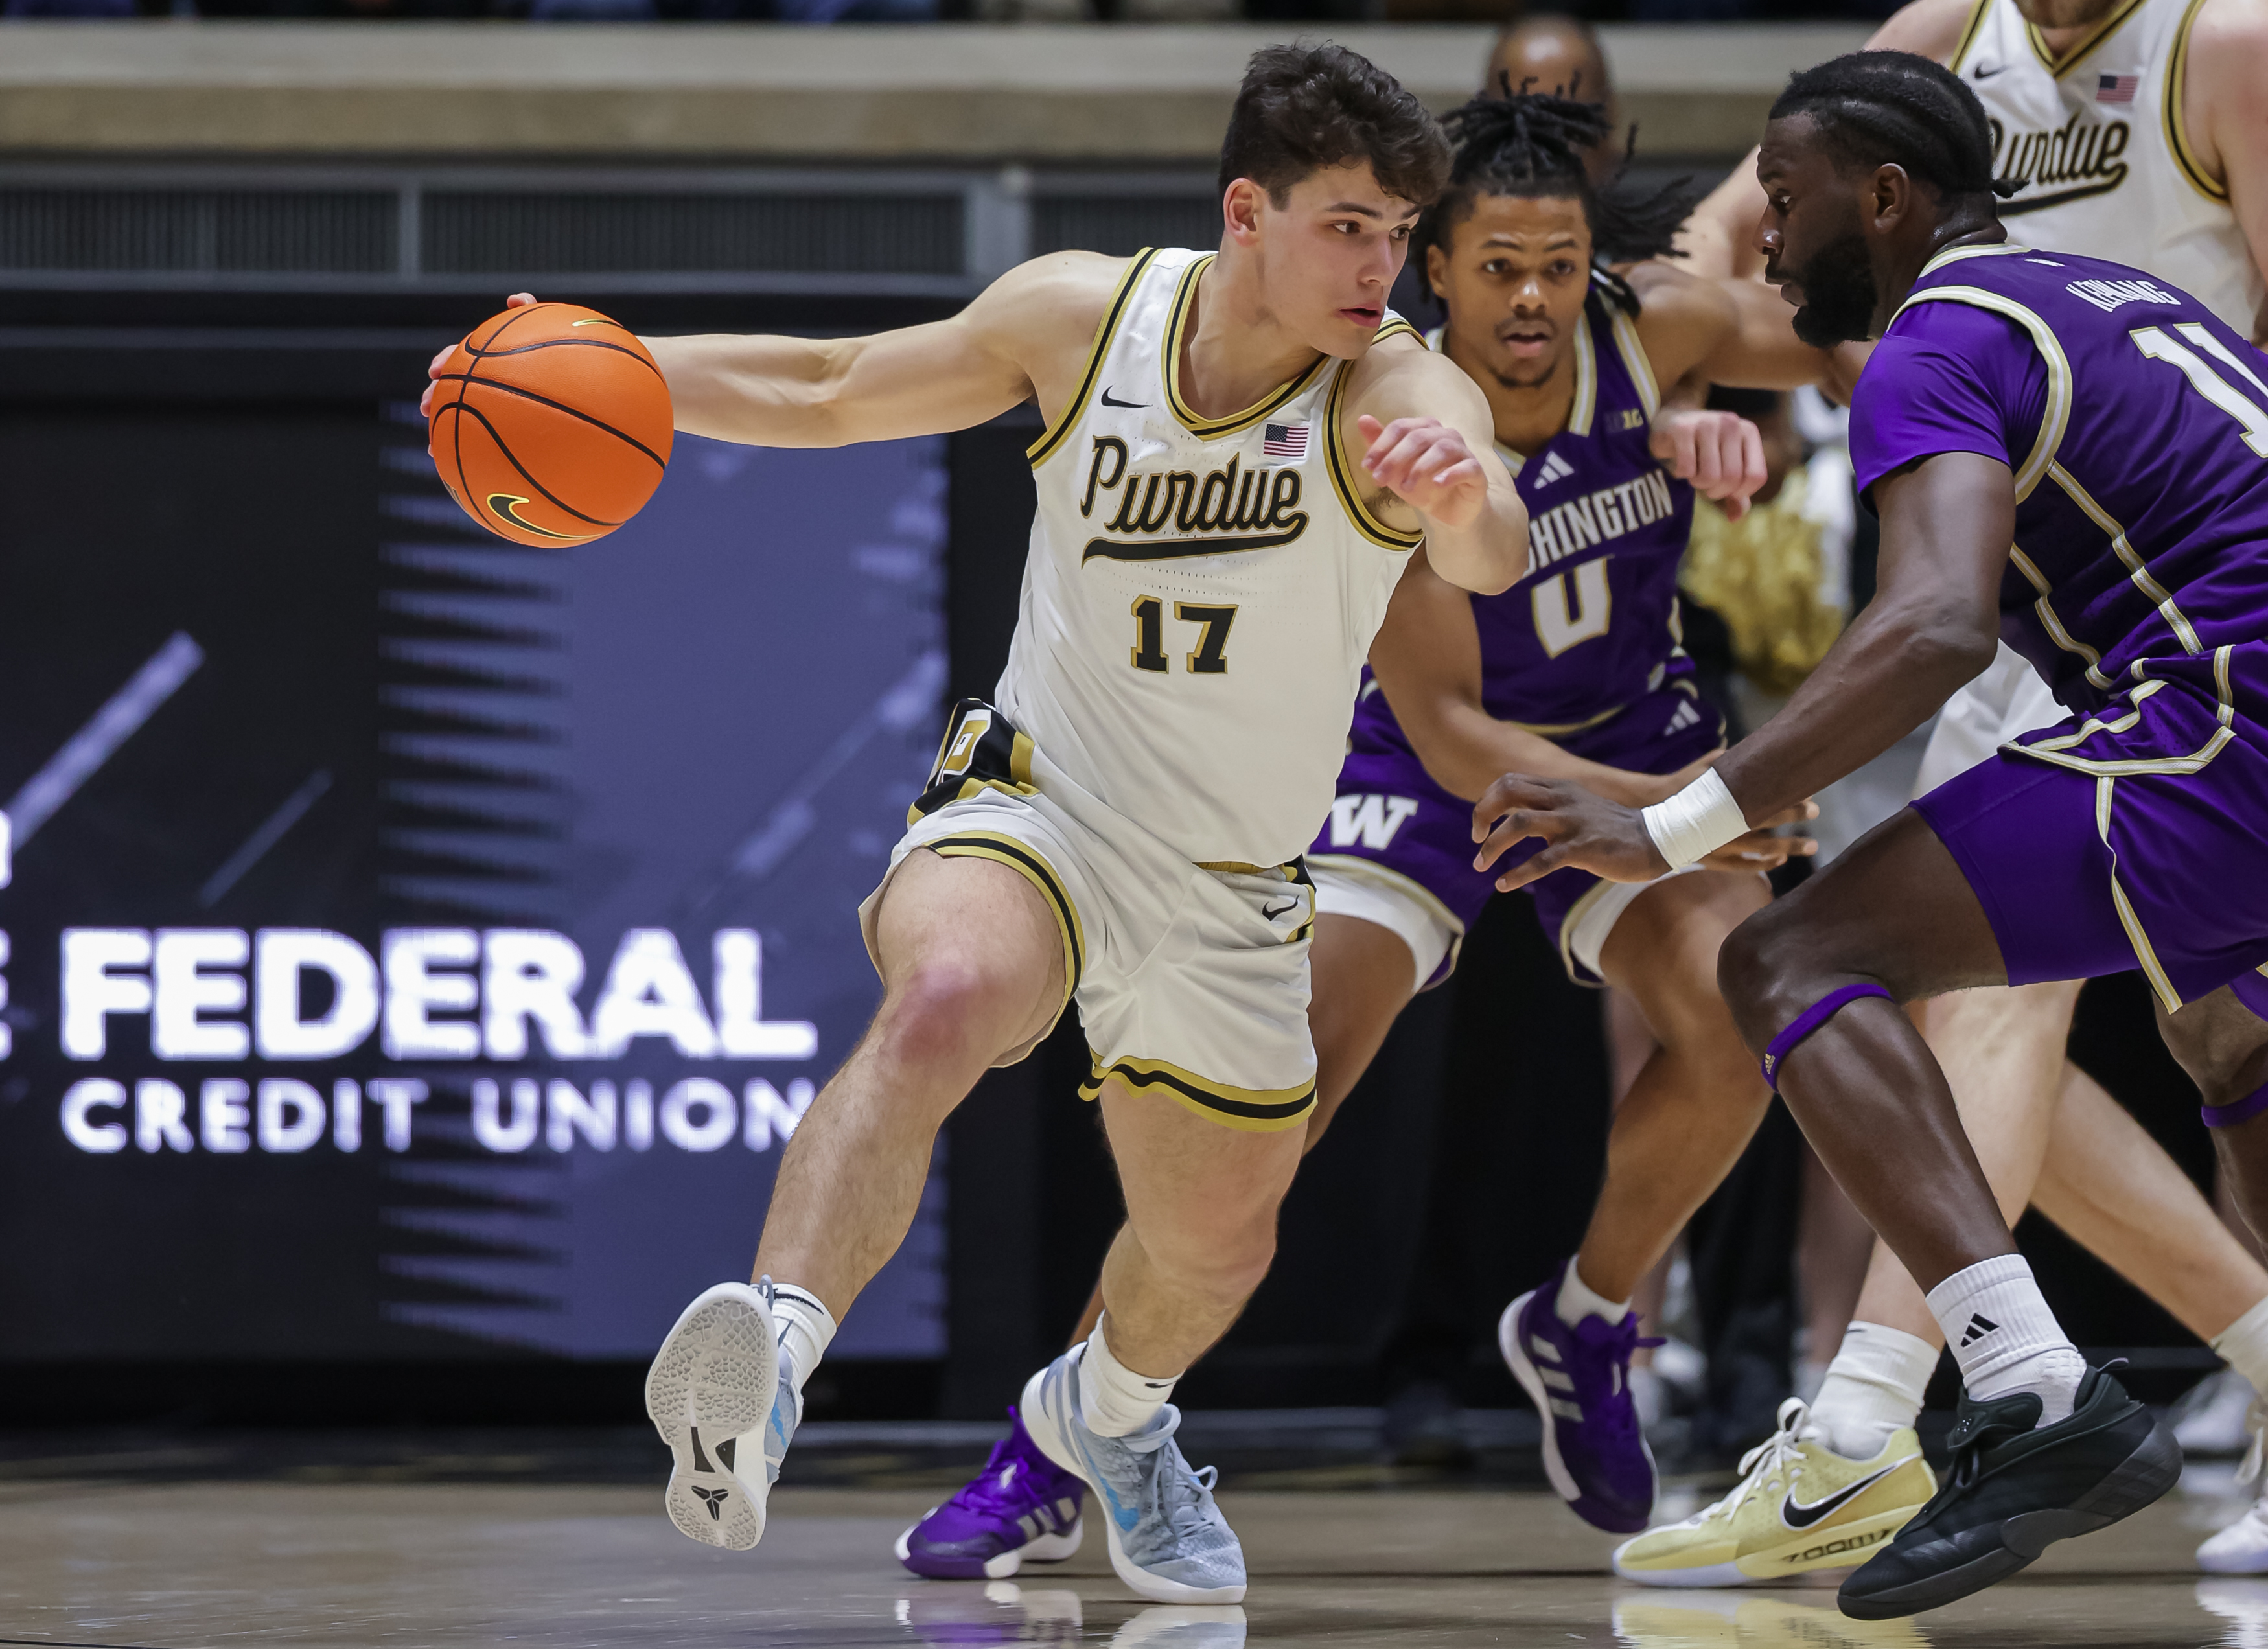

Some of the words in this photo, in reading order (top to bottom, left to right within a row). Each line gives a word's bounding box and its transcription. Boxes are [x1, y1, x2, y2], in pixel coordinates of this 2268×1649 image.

[1080, 435, 1310, 538] Purdue
[1131, 594, 1240, 674] 17
[1530, 556, 1613, 660] 0
[1330, 794, 1419, 851] W
[59, 926, 818, 1061] FEDERAL
[59, 1076, 430, 1153] CREDIT
[471, 1076, 817, 1153] UNION
